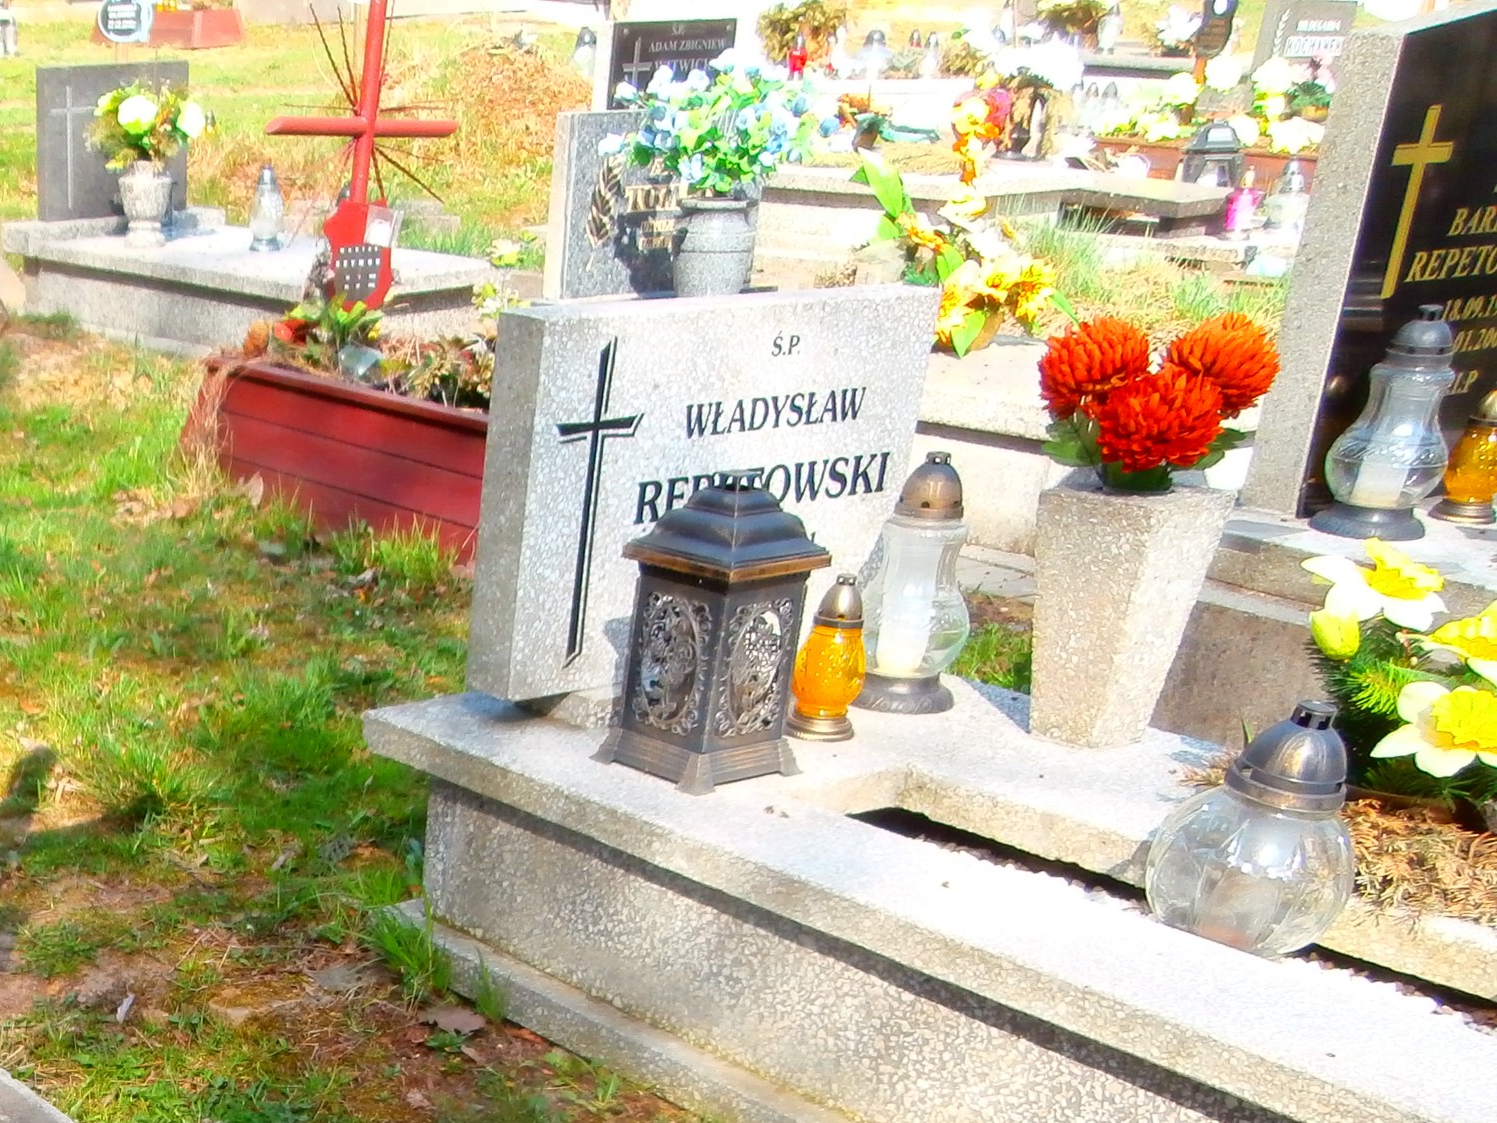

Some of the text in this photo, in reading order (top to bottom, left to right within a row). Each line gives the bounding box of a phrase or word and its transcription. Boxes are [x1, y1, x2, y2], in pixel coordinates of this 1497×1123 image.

[648, 41, 678, 53] ADAM
[771, 330, 801, 357] Ś.P.
[686, 387, 867, 439] WŁADYSŁAW
[634, 451, 891, 525] REOWSKI
